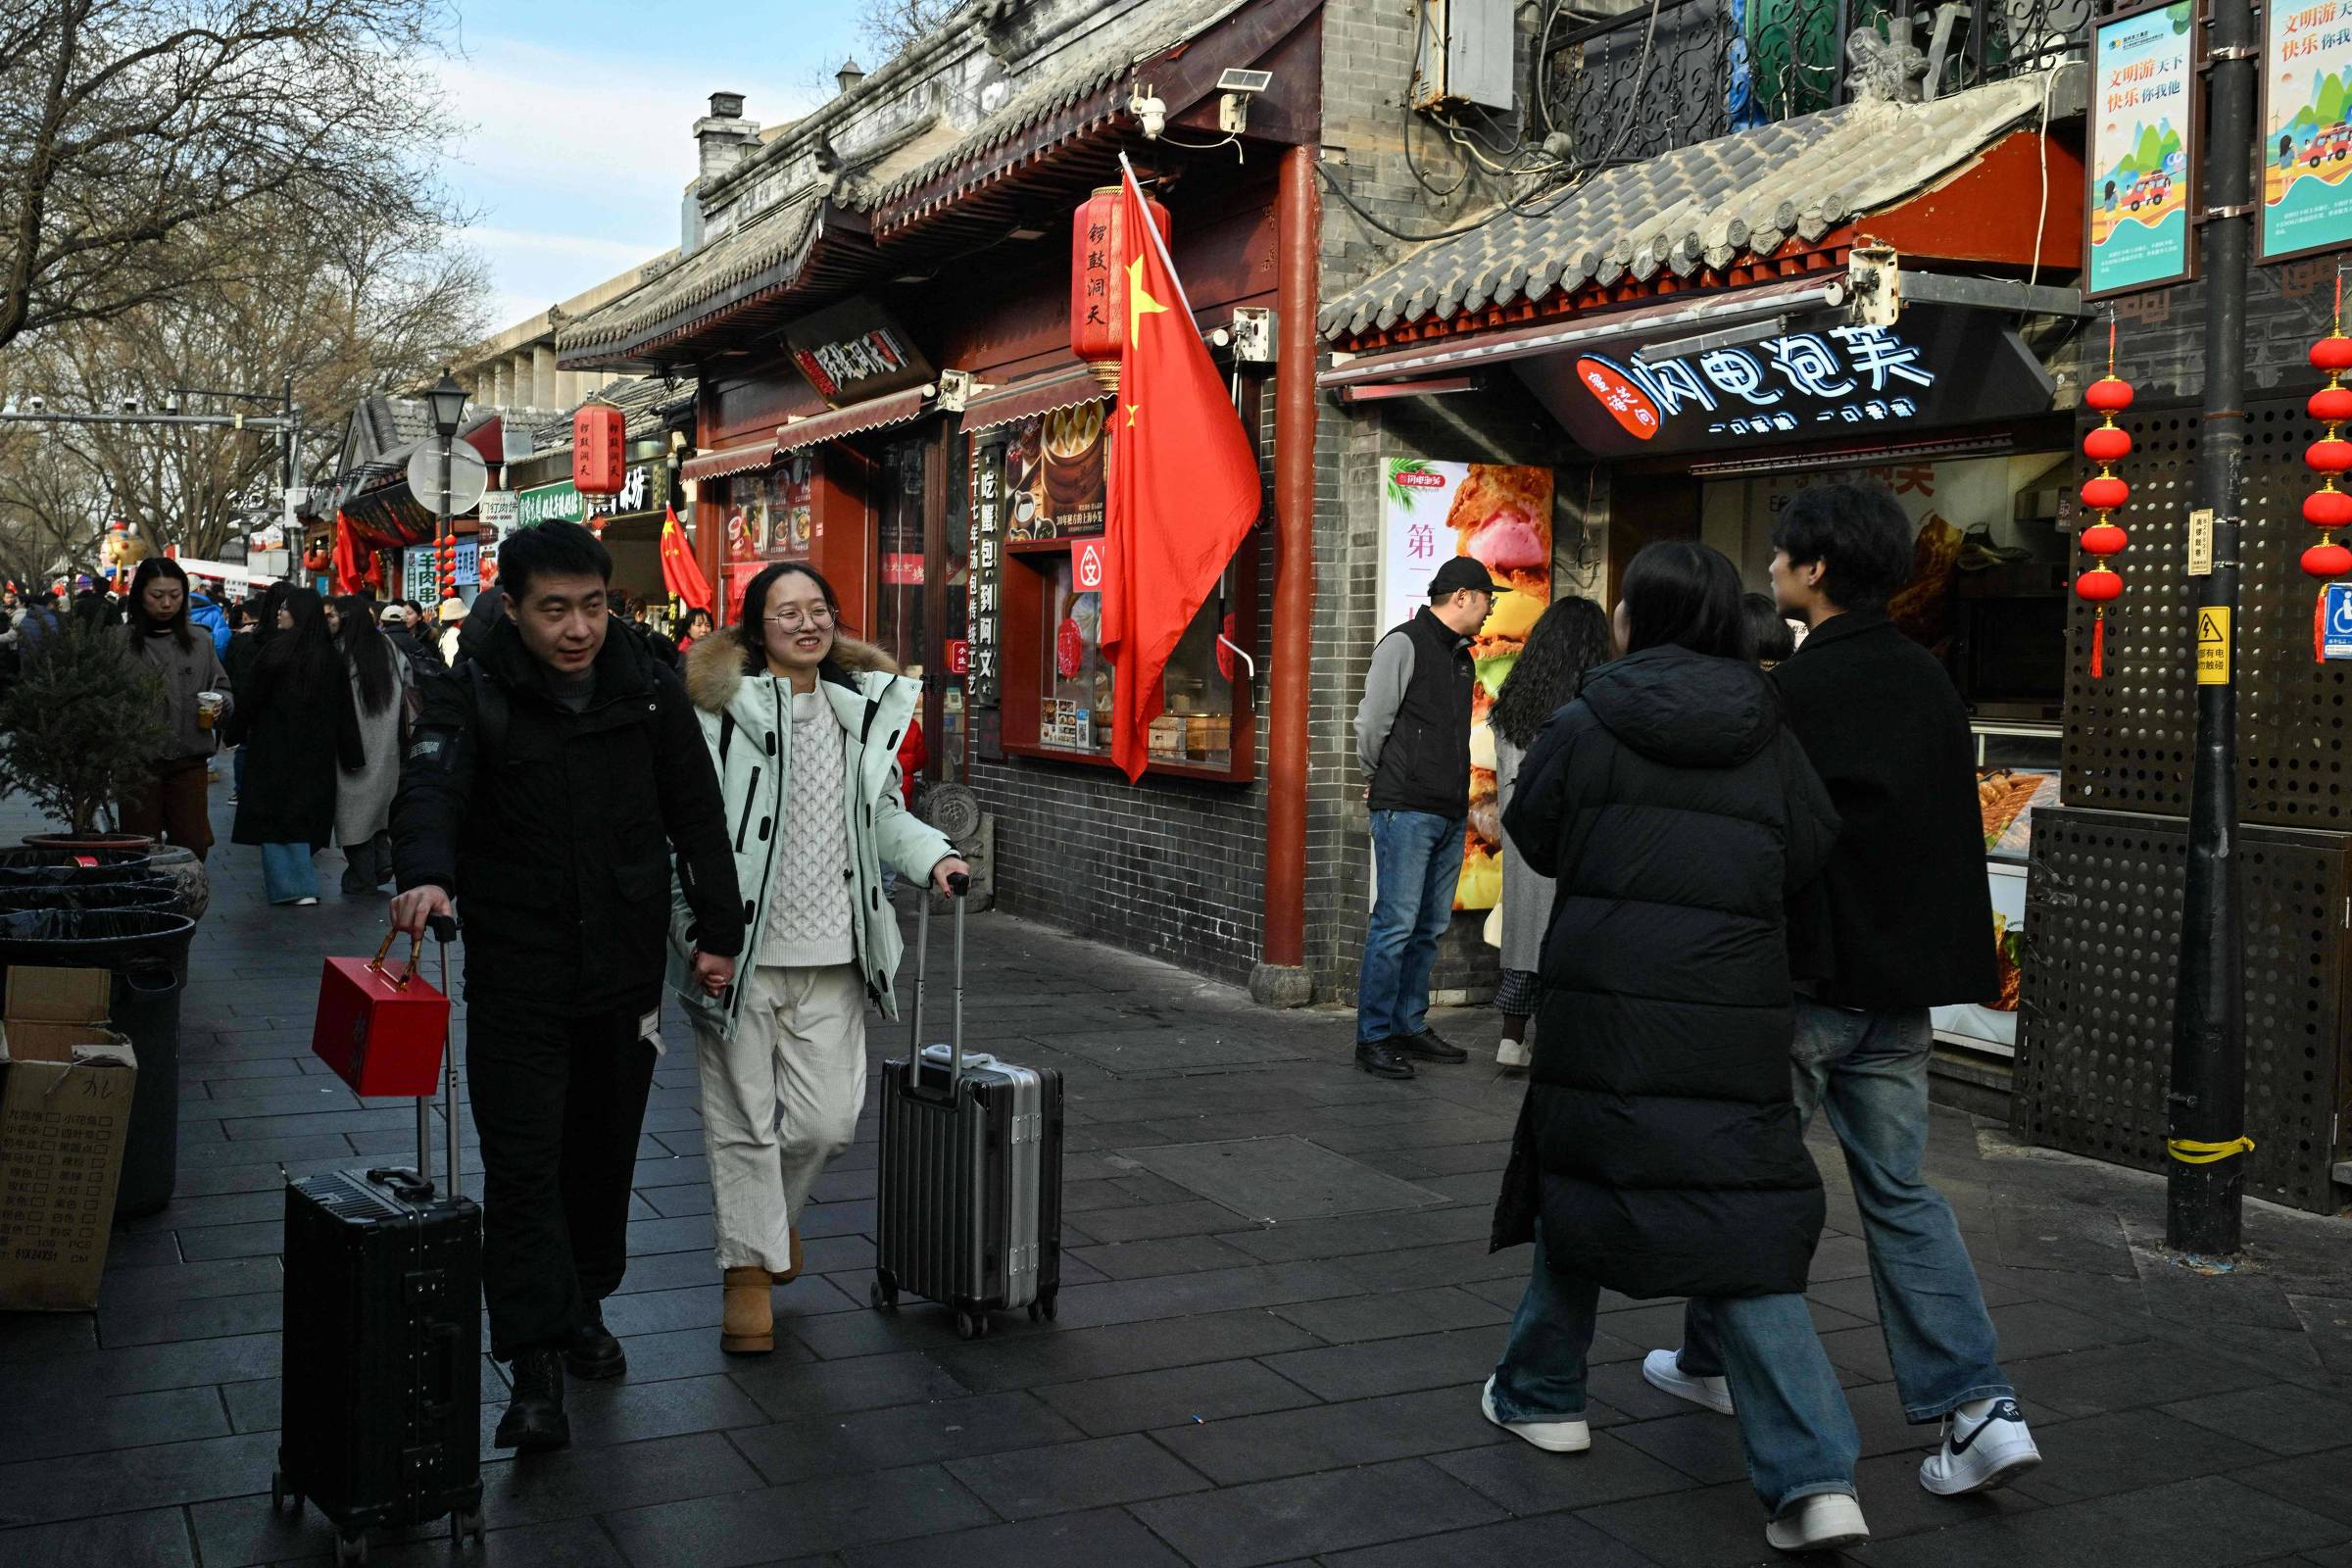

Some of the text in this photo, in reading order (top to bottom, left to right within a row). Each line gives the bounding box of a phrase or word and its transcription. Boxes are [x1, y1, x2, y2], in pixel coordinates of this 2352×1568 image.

[2108, 54, 2182, 89] 文明游天下
[2108, 80, 2180, 113] 快乐你我他
[1632, 324, 1935, 416] 闪电泡芙
[479, 501, 518, 514] 门钉肉饼
[418, 553, 437, 605] 羊肉串
[1405, 523, 1436, 621] 第二
